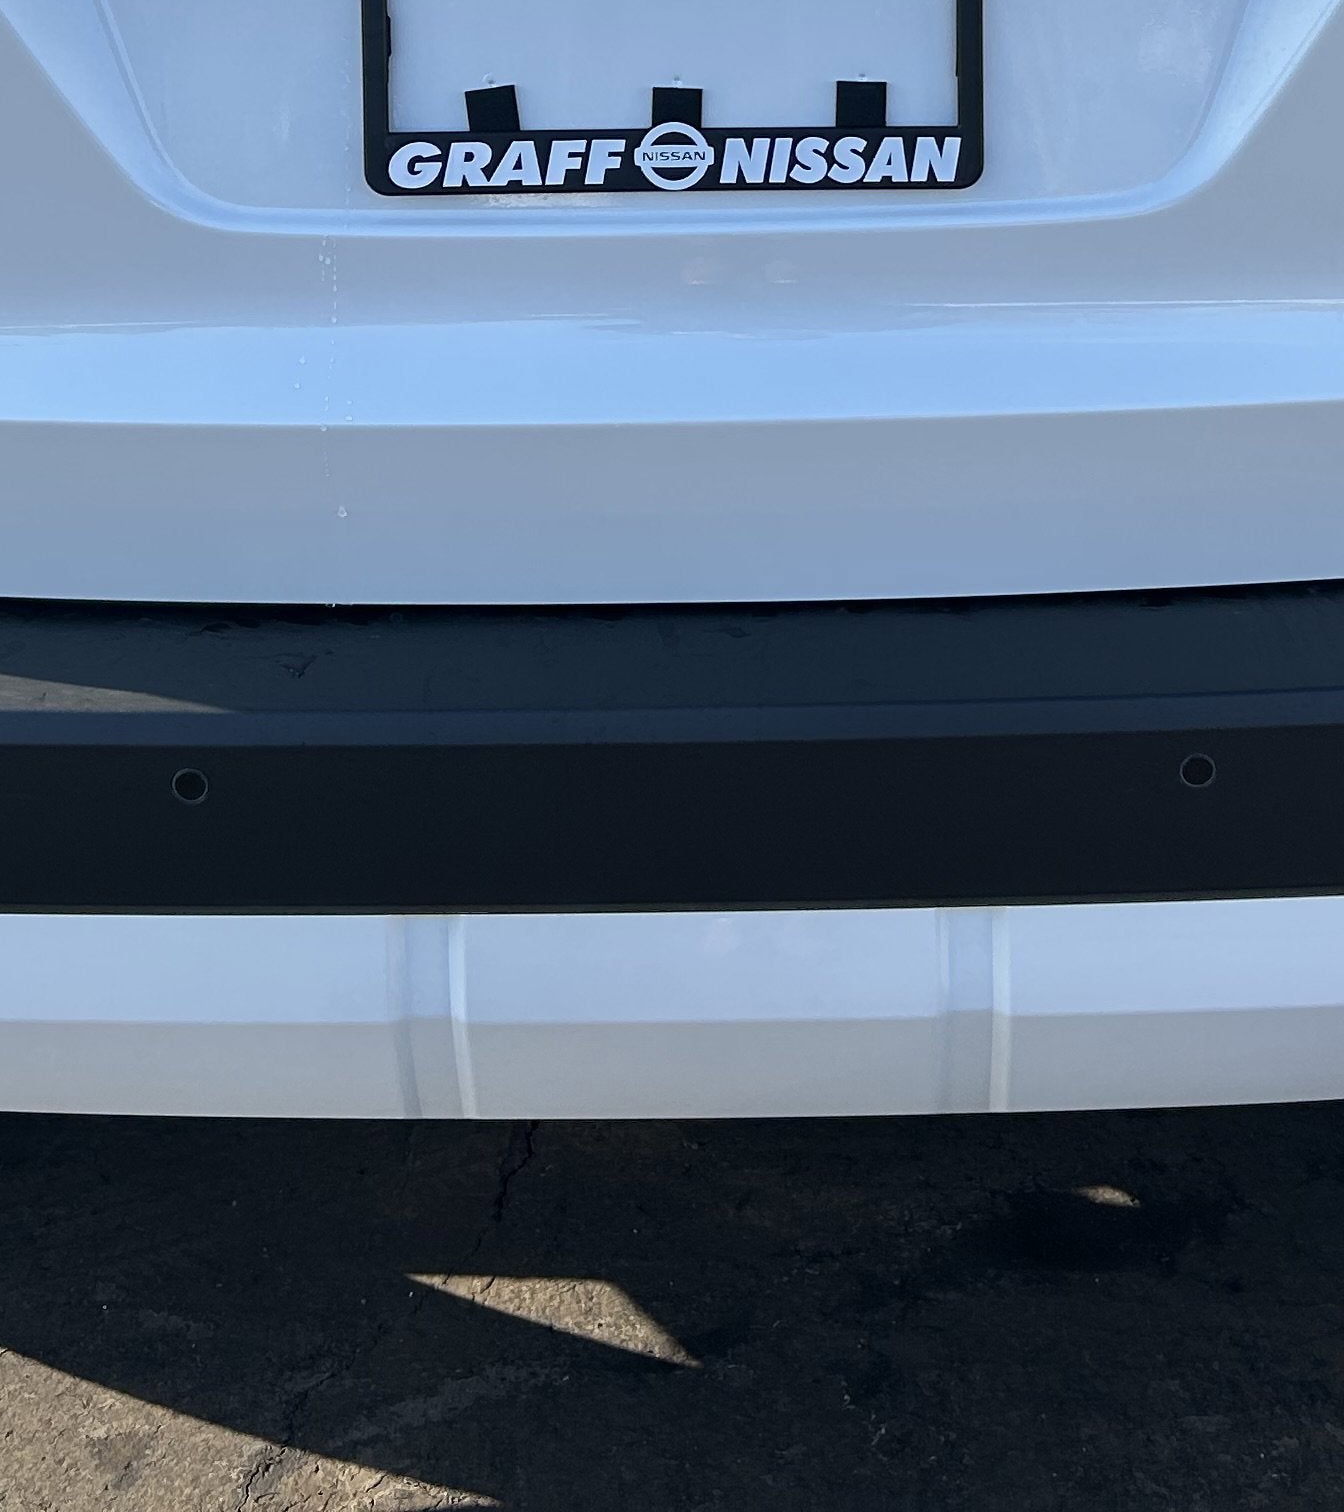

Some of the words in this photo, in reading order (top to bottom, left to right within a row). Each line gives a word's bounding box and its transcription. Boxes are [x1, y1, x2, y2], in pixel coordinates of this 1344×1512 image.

[388, 140, 626, 187] GRAFF
[720, 137, 962, 184] NISSAN
[642, 151, 706, 162] NISSAN
